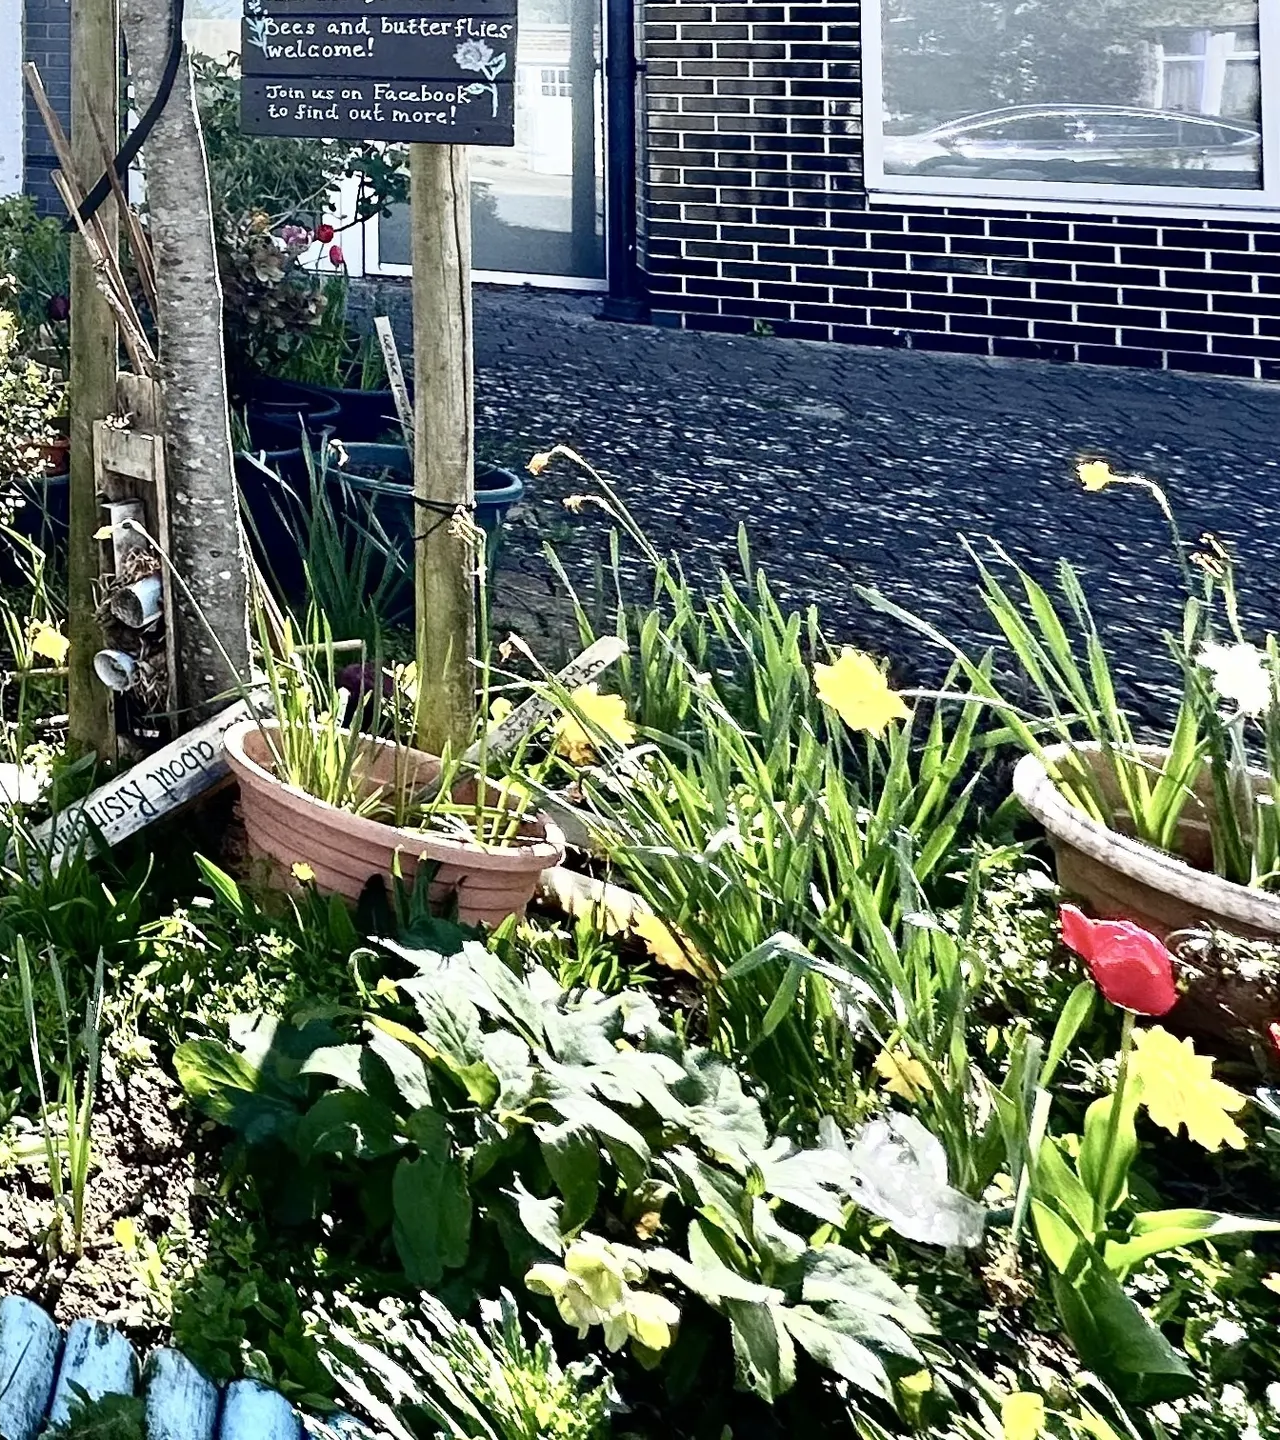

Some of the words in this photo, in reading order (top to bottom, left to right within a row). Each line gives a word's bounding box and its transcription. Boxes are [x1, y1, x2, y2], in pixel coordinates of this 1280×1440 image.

[264, 17, 315, 36] Bees
[327, 16, 371, 35] and
[380, 16, 513, 39] butterflies
[267, 37, 375, 58] welcome!
[265, 85, 306, 99] Join
[311, 89, 335, 100] us
[341, 89, 363, 100] on
[373, 83, 472, 104] Facebook
[267, 104, 289, 118] to
[294, 103, 339, 120] find
[349, 103, 385, 121] out
[392, 105, 457, 125] more!
[146, 739, 215, 802] about
